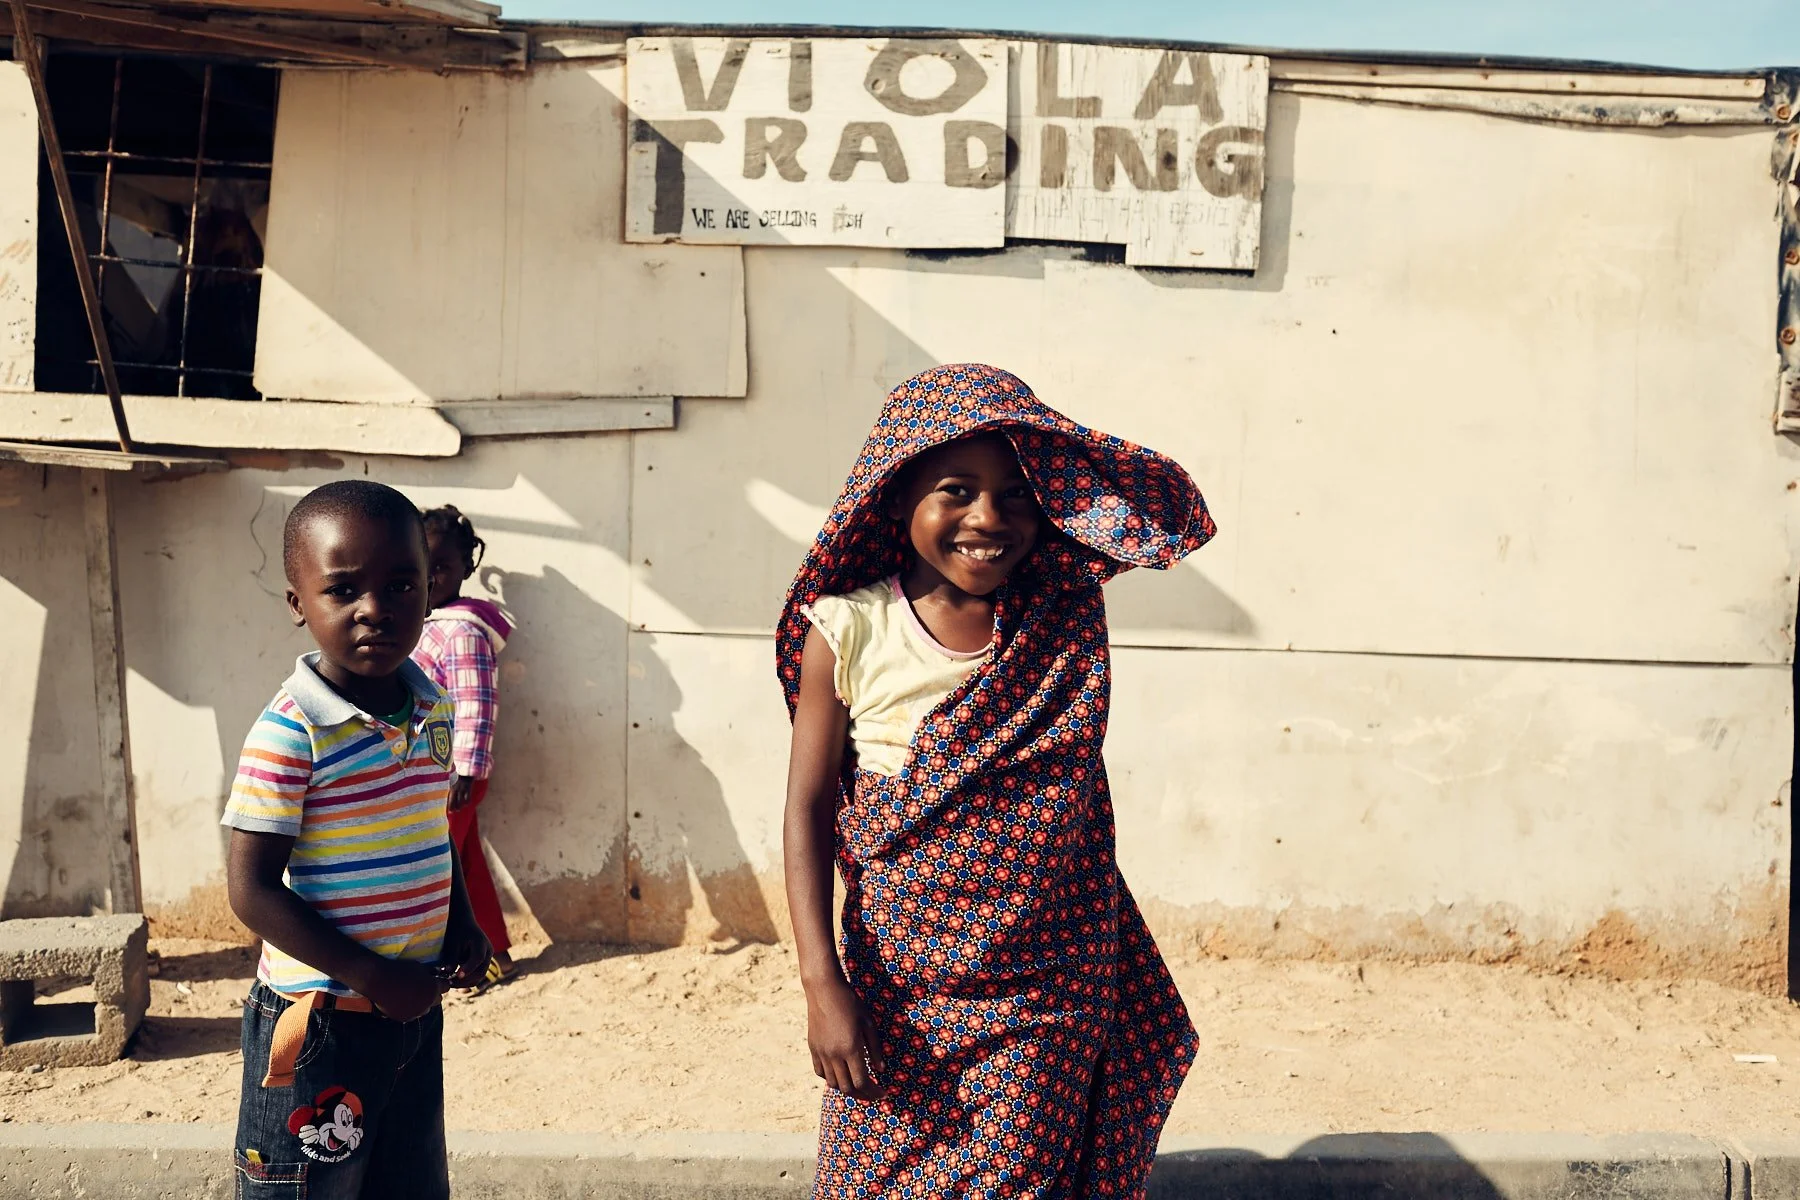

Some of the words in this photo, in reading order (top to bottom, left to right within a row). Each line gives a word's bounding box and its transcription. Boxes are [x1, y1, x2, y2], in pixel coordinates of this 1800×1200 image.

[669, 38, 1224, 126] VIOLA
[634, 117, 1266, 234] TRADING
[692, 208, 716, 229] WE
[726, 208, 750, 229] ARE
[758, 209, 817, 229] SELLING
[301, 1145, 318, 1159] Hide
[319, 1154, 336, 1162] and
